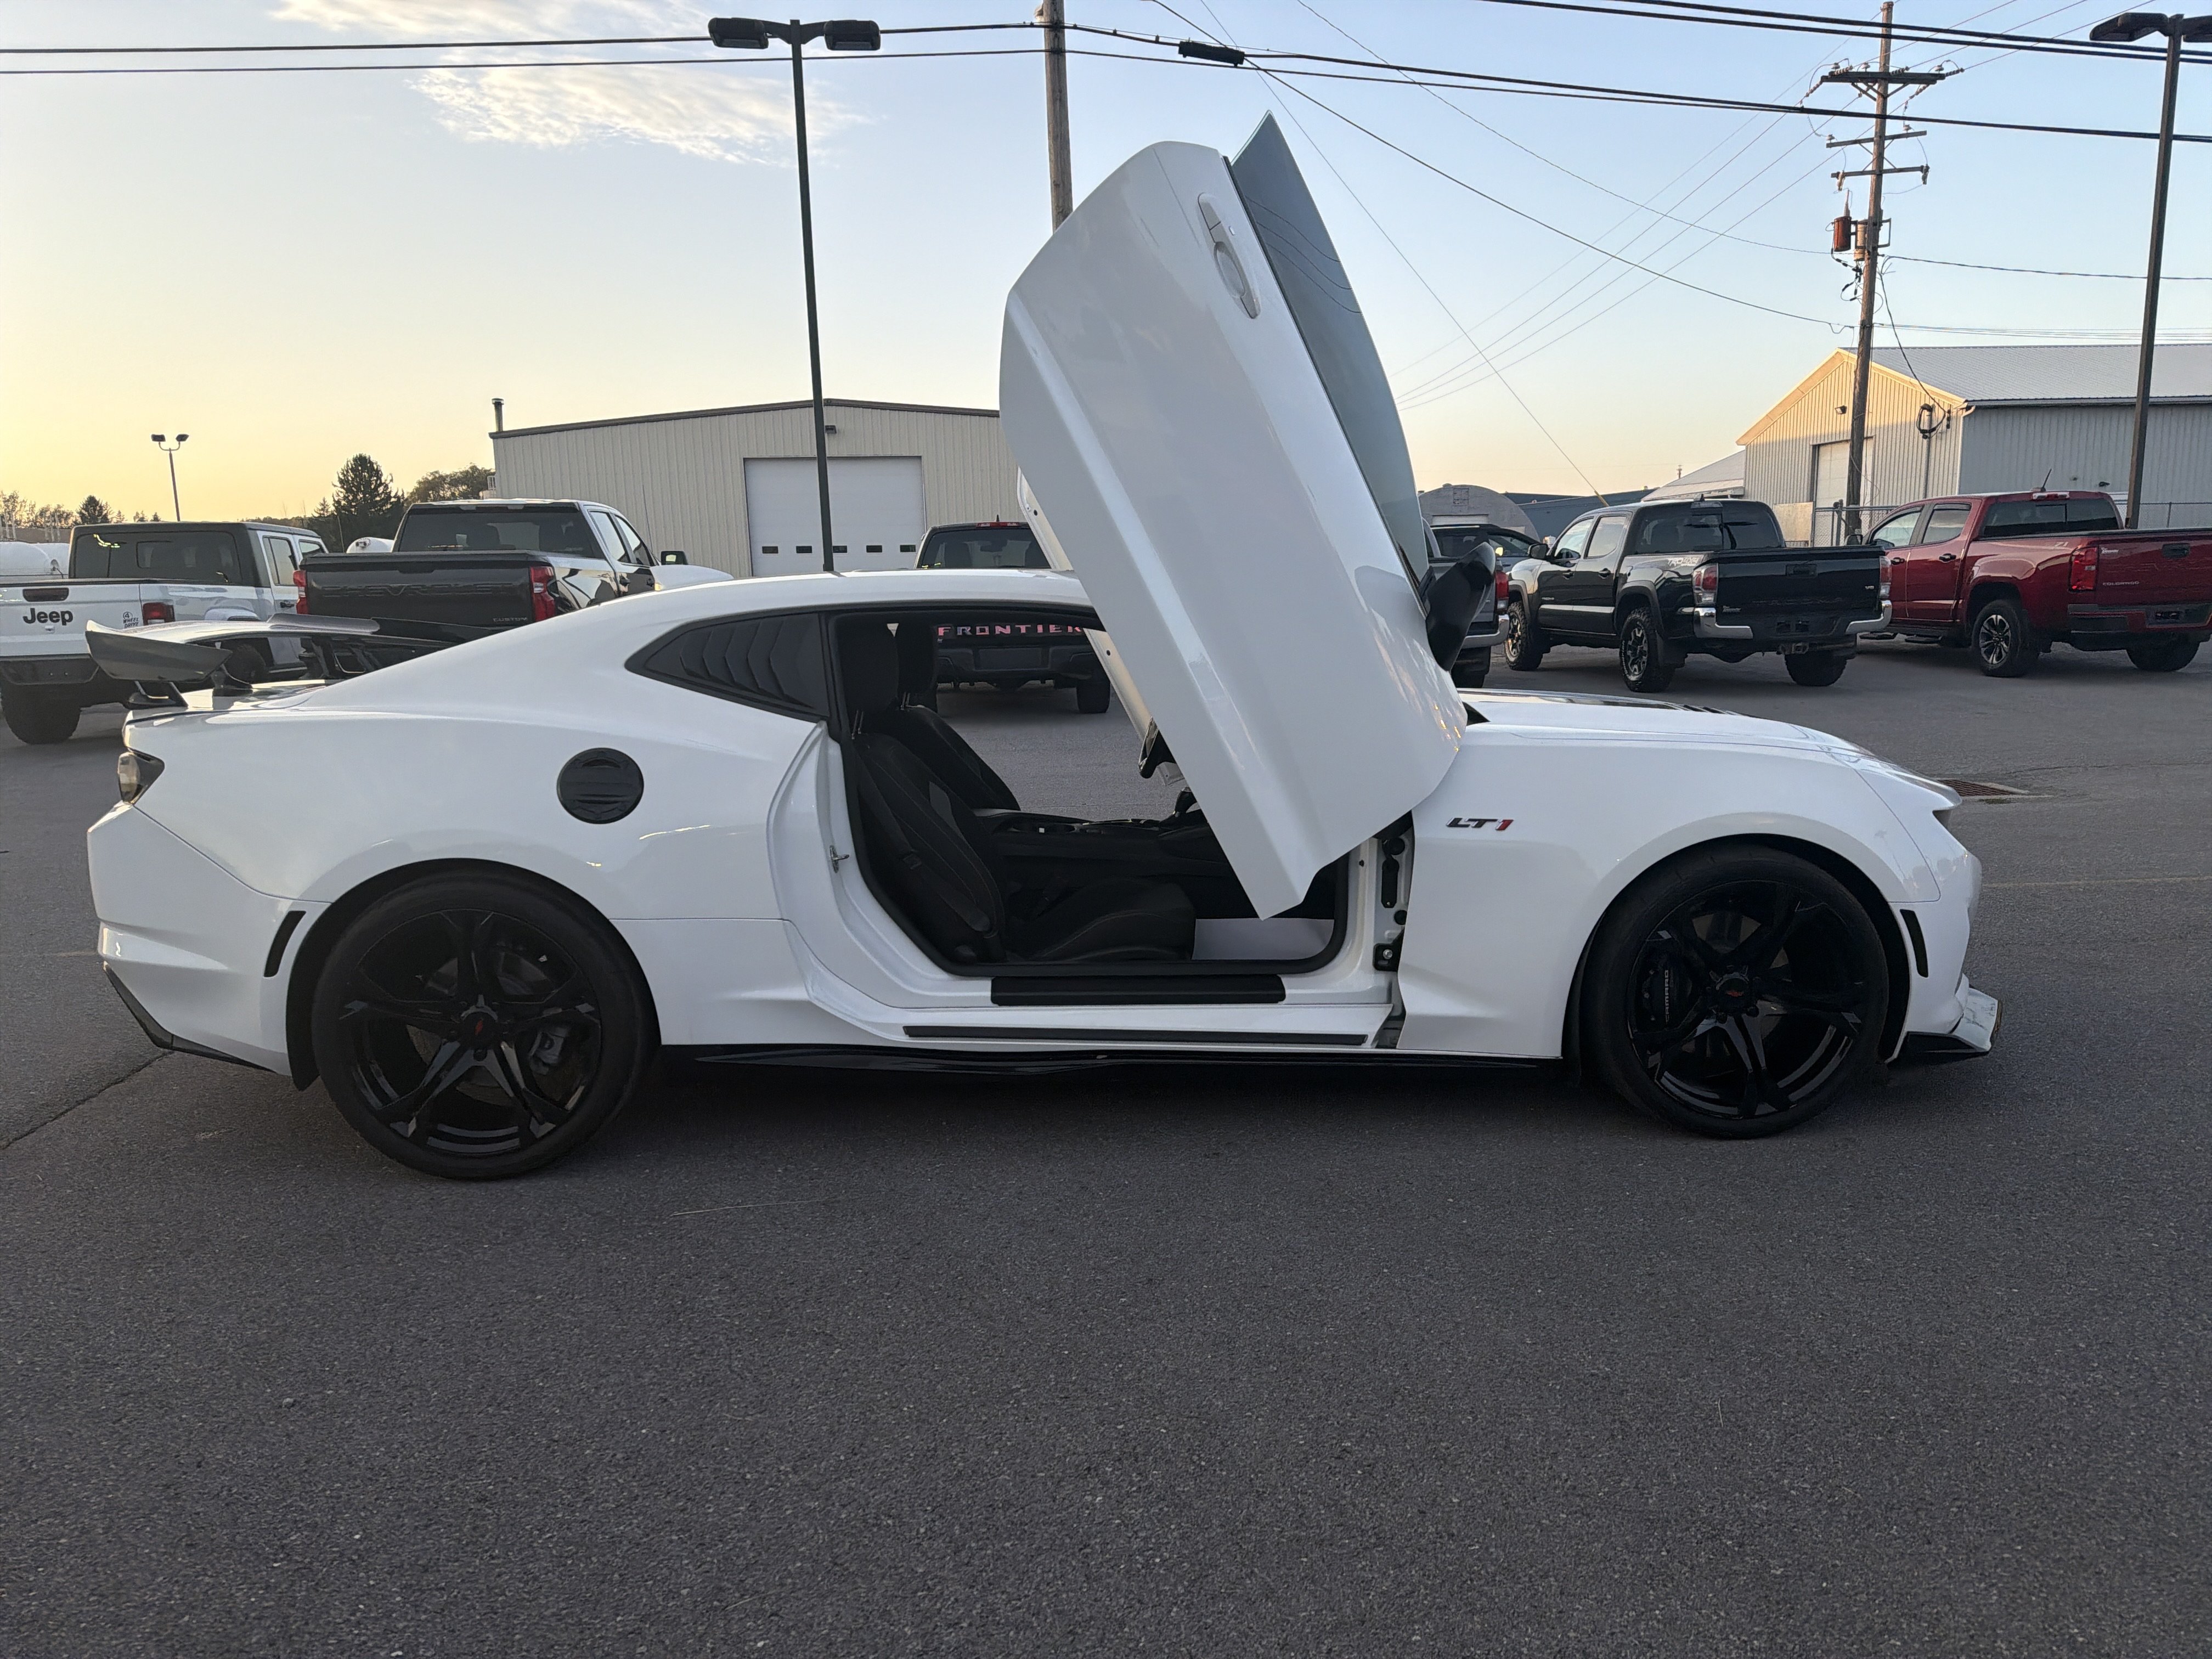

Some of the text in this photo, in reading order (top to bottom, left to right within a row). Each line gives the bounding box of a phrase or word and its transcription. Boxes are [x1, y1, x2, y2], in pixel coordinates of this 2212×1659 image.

[1668, 557, 1684, 567] TRD
[22, 607, 74, 626] Jeep
[938, 624, 1082, 635] FRONTIER
[1446, 817, 1514, 831] LT1
